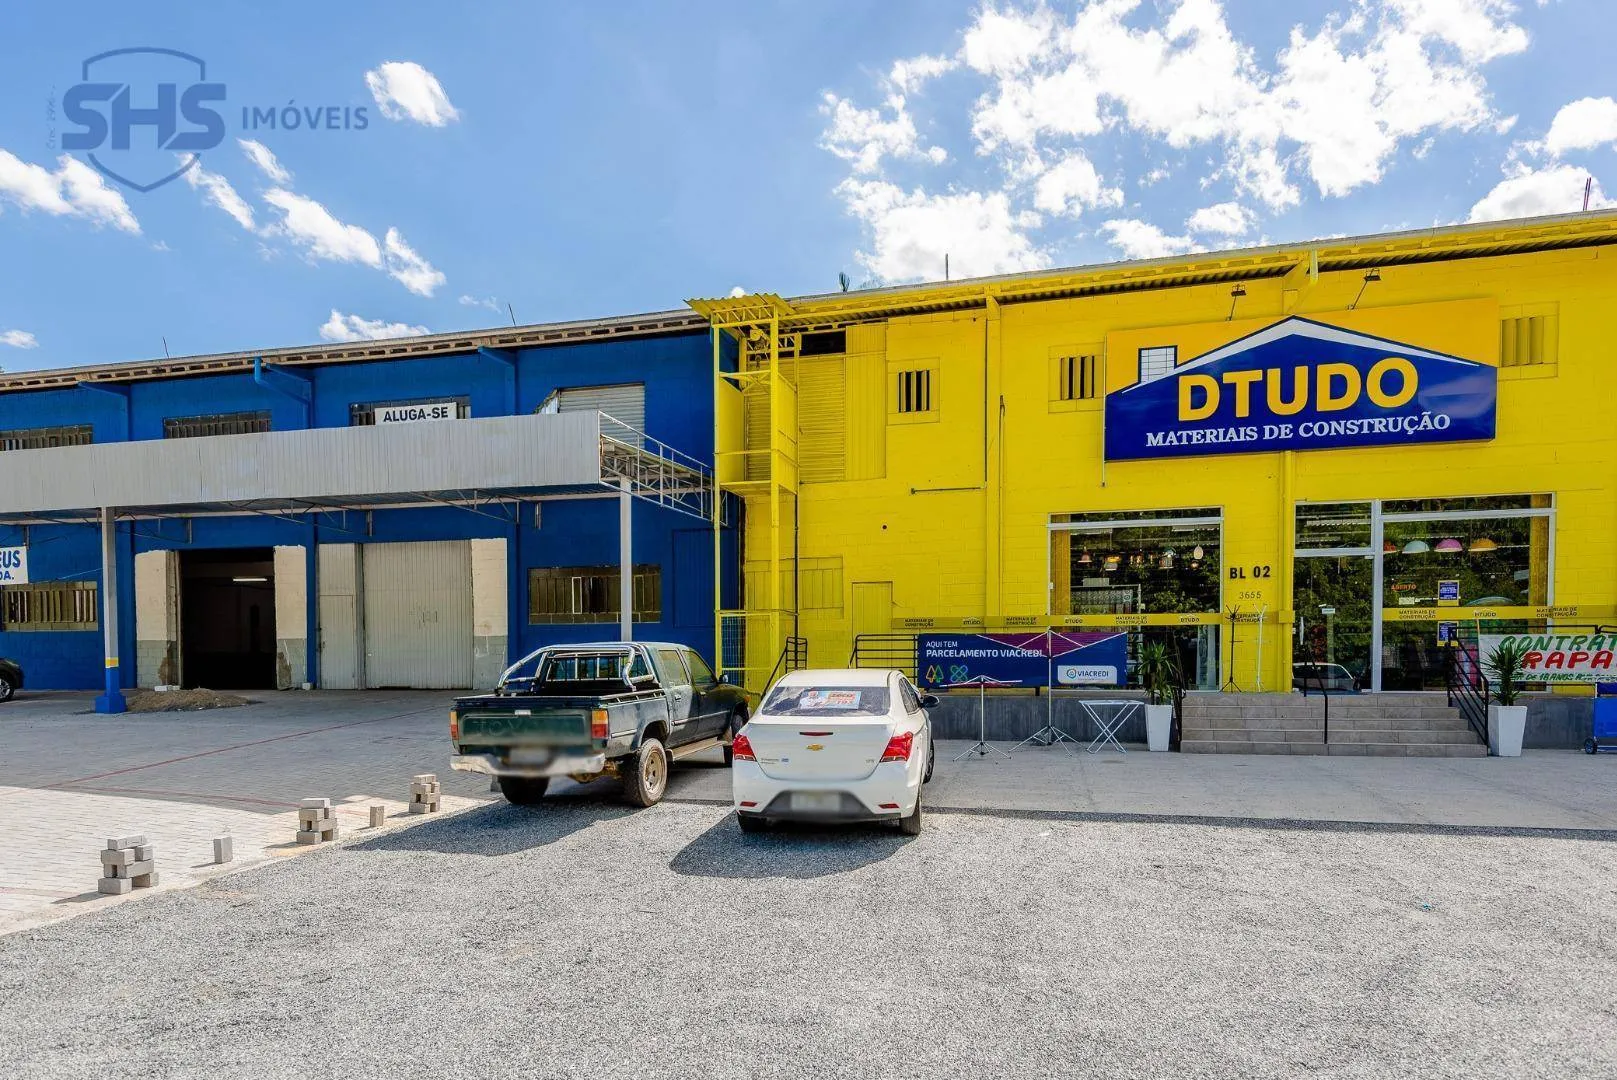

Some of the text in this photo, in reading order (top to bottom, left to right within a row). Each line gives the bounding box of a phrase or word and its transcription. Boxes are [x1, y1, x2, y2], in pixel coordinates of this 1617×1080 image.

[1178, 357, 1419, 422] DTUDO
[383, 406, 449, 422] ALUGA-SE
[1146, 411, 1451, 447] MATERIAIS DE CONSTRUÇÃO
[1230, 565, 1271, 579] BL 02
[1239, 591, 1262, 600] 3655
[926, 649, 1043, 658] PARCELAMENTO VIACREDI
[1521, 651, 1617, 669] RAPA
[1077, 670, 1109, 678] VIACREDI
